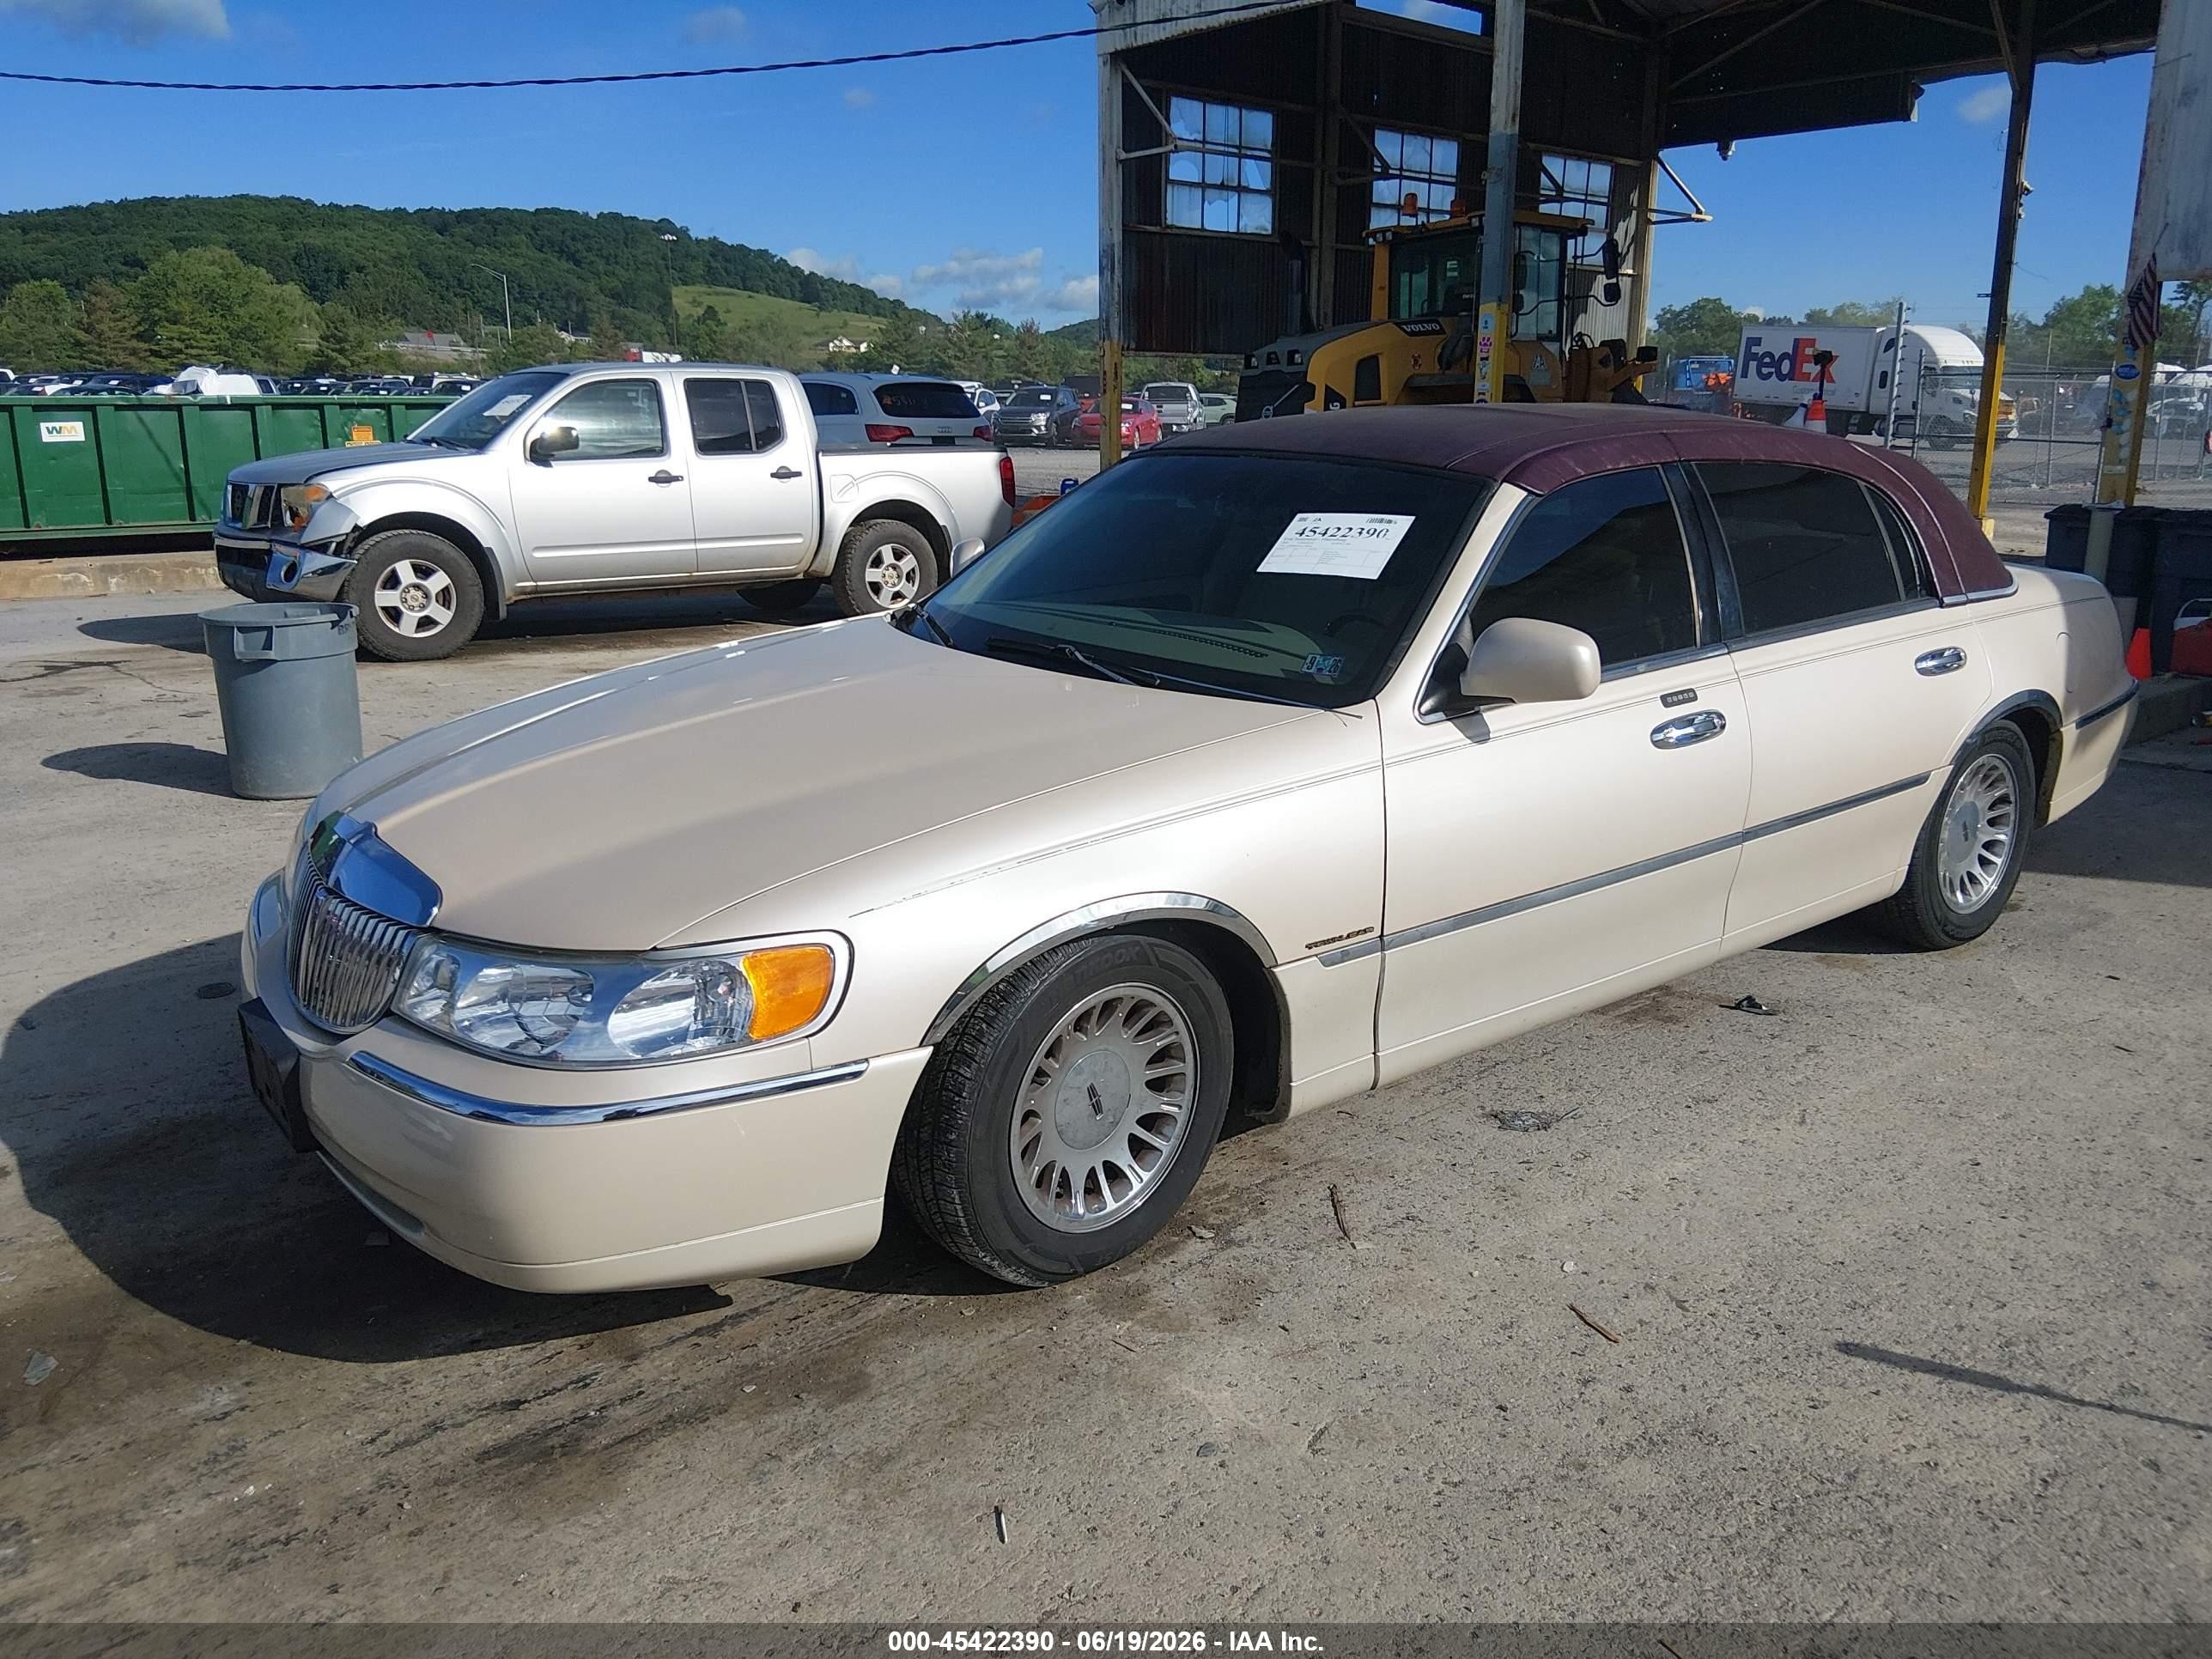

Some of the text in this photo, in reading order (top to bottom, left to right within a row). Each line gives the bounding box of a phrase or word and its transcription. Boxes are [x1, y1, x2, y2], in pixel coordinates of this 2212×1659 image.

[1402, 321, 1441, 332] VOLVO
[1741, 337, 1841, 384] FedEx
[46, 425, 77, 434] WM
[1295, 526, 1389, 539] 45422390
